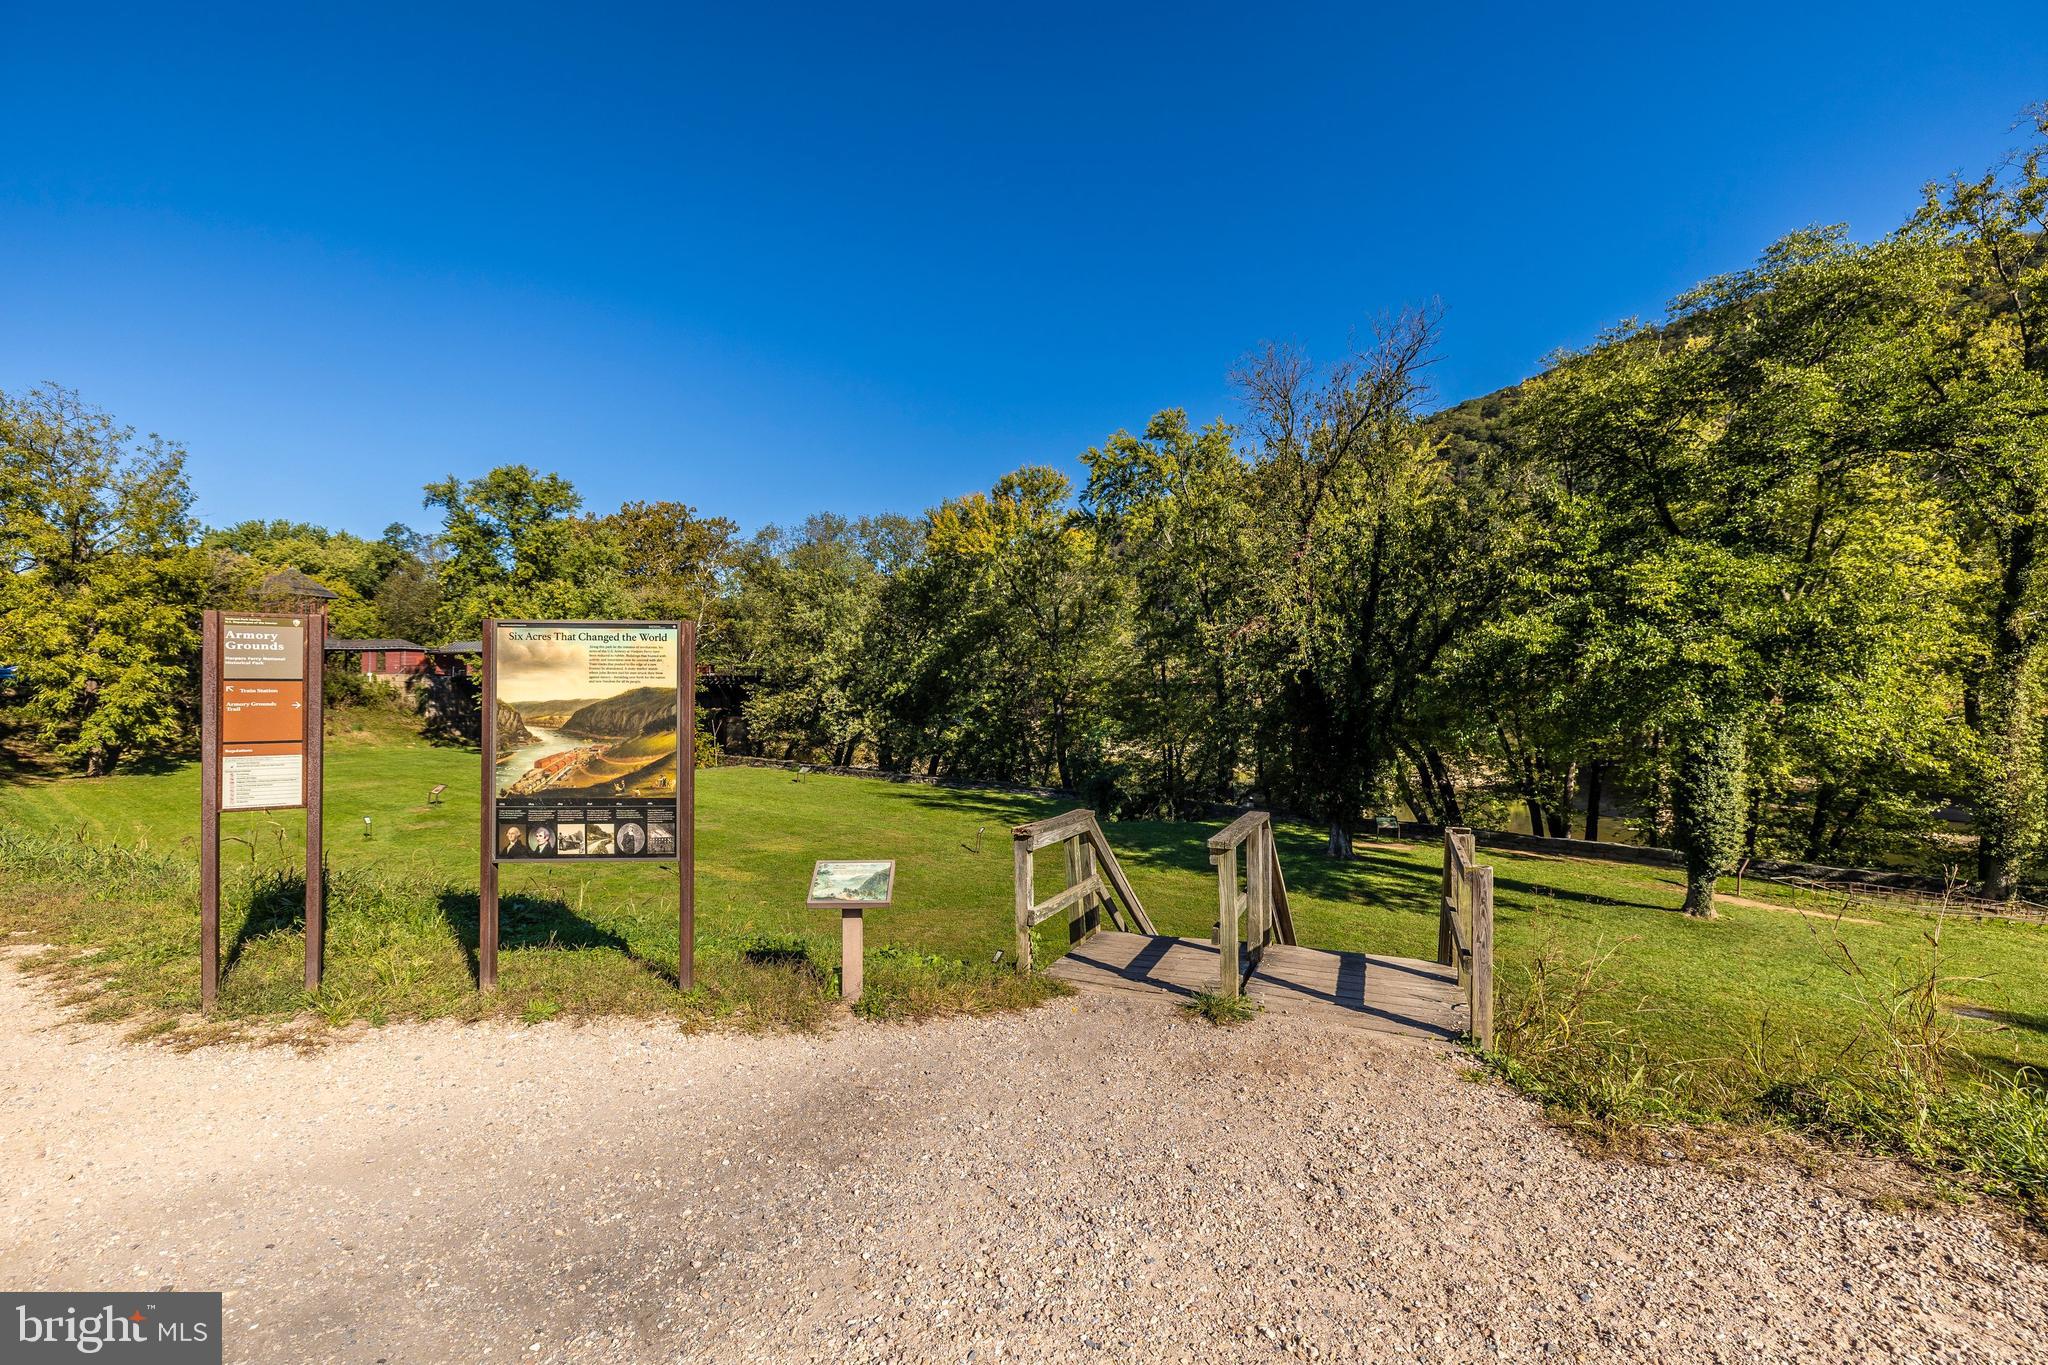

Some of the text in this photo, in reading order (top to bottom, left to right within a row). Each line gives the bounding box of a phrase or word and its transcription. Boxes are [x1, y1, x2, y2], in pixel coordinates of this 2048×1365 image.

[225, 630, 278, 642] Armory
[508, 632, 668, 644] Six Acres That Changed the World
[225, 641, 285, 651] Grounds
